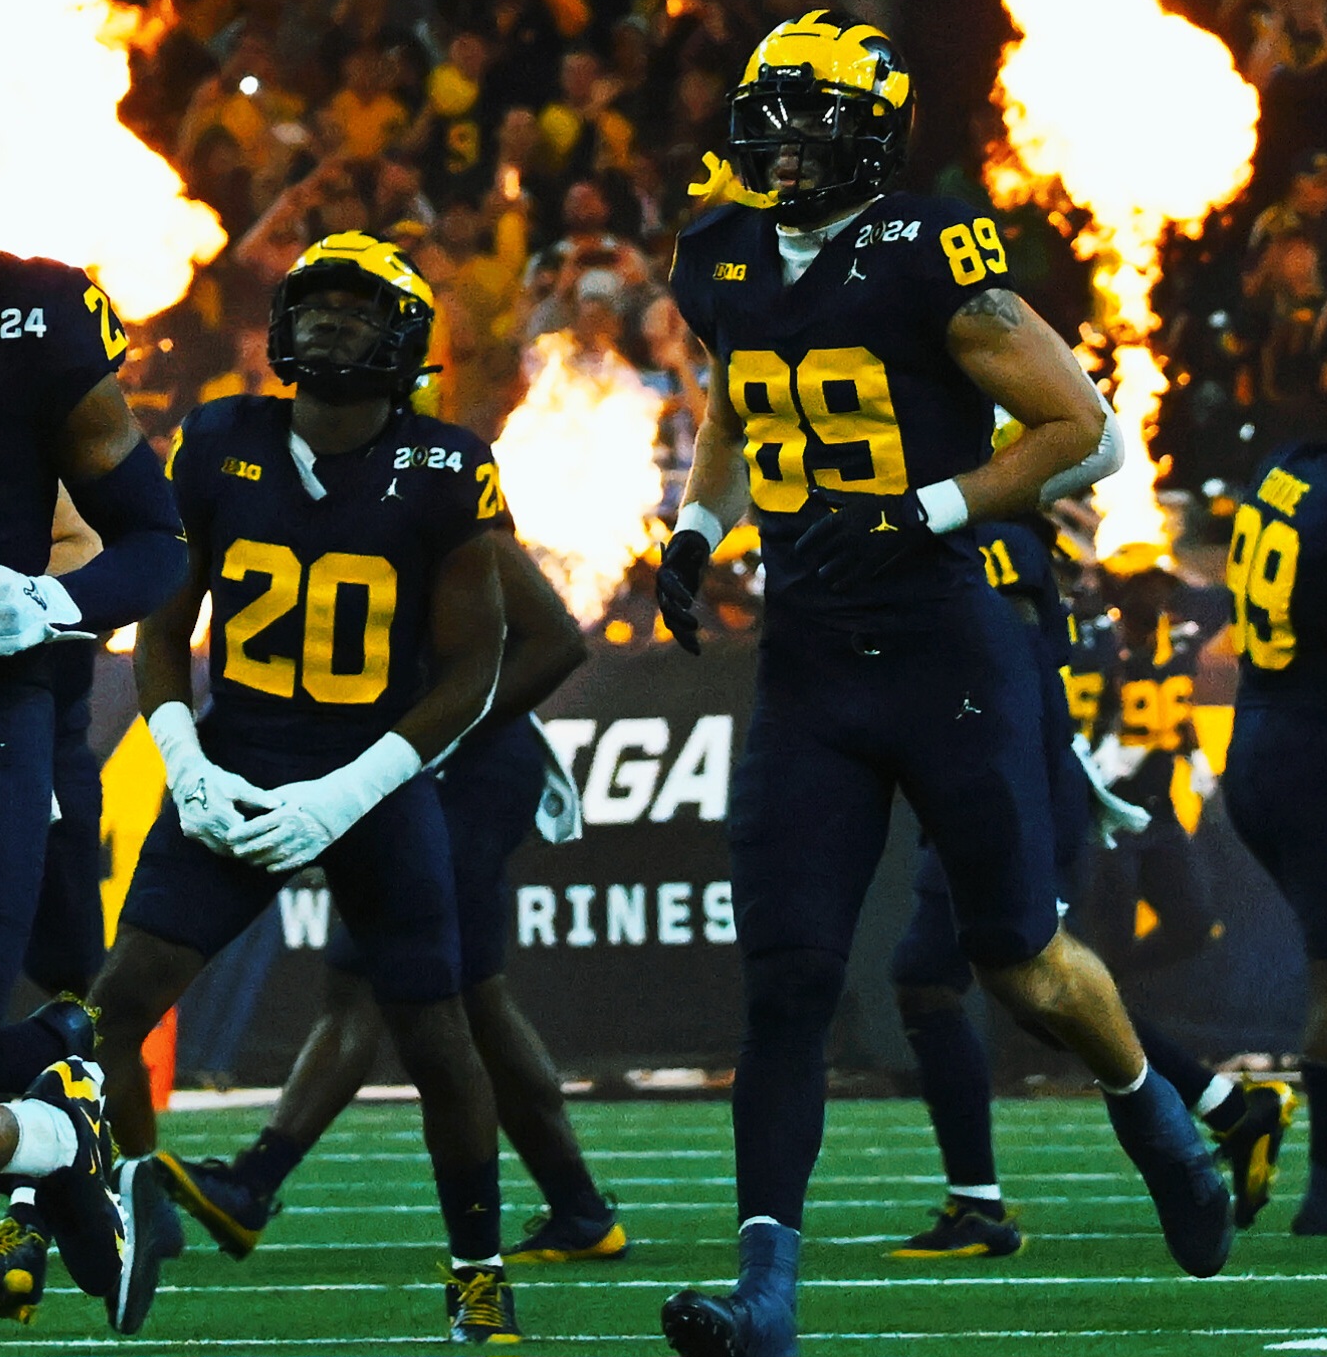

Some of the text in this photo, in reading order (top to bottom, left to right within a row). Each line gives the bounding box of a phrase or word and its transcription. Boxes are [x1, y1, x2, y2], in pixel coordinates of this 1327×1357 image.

[939, 217, 1008, 286] 89
[728, 346, 909, 513] 89
[221, 538, 397, 705] 20
[1226, 503, 1300, 670] 99
